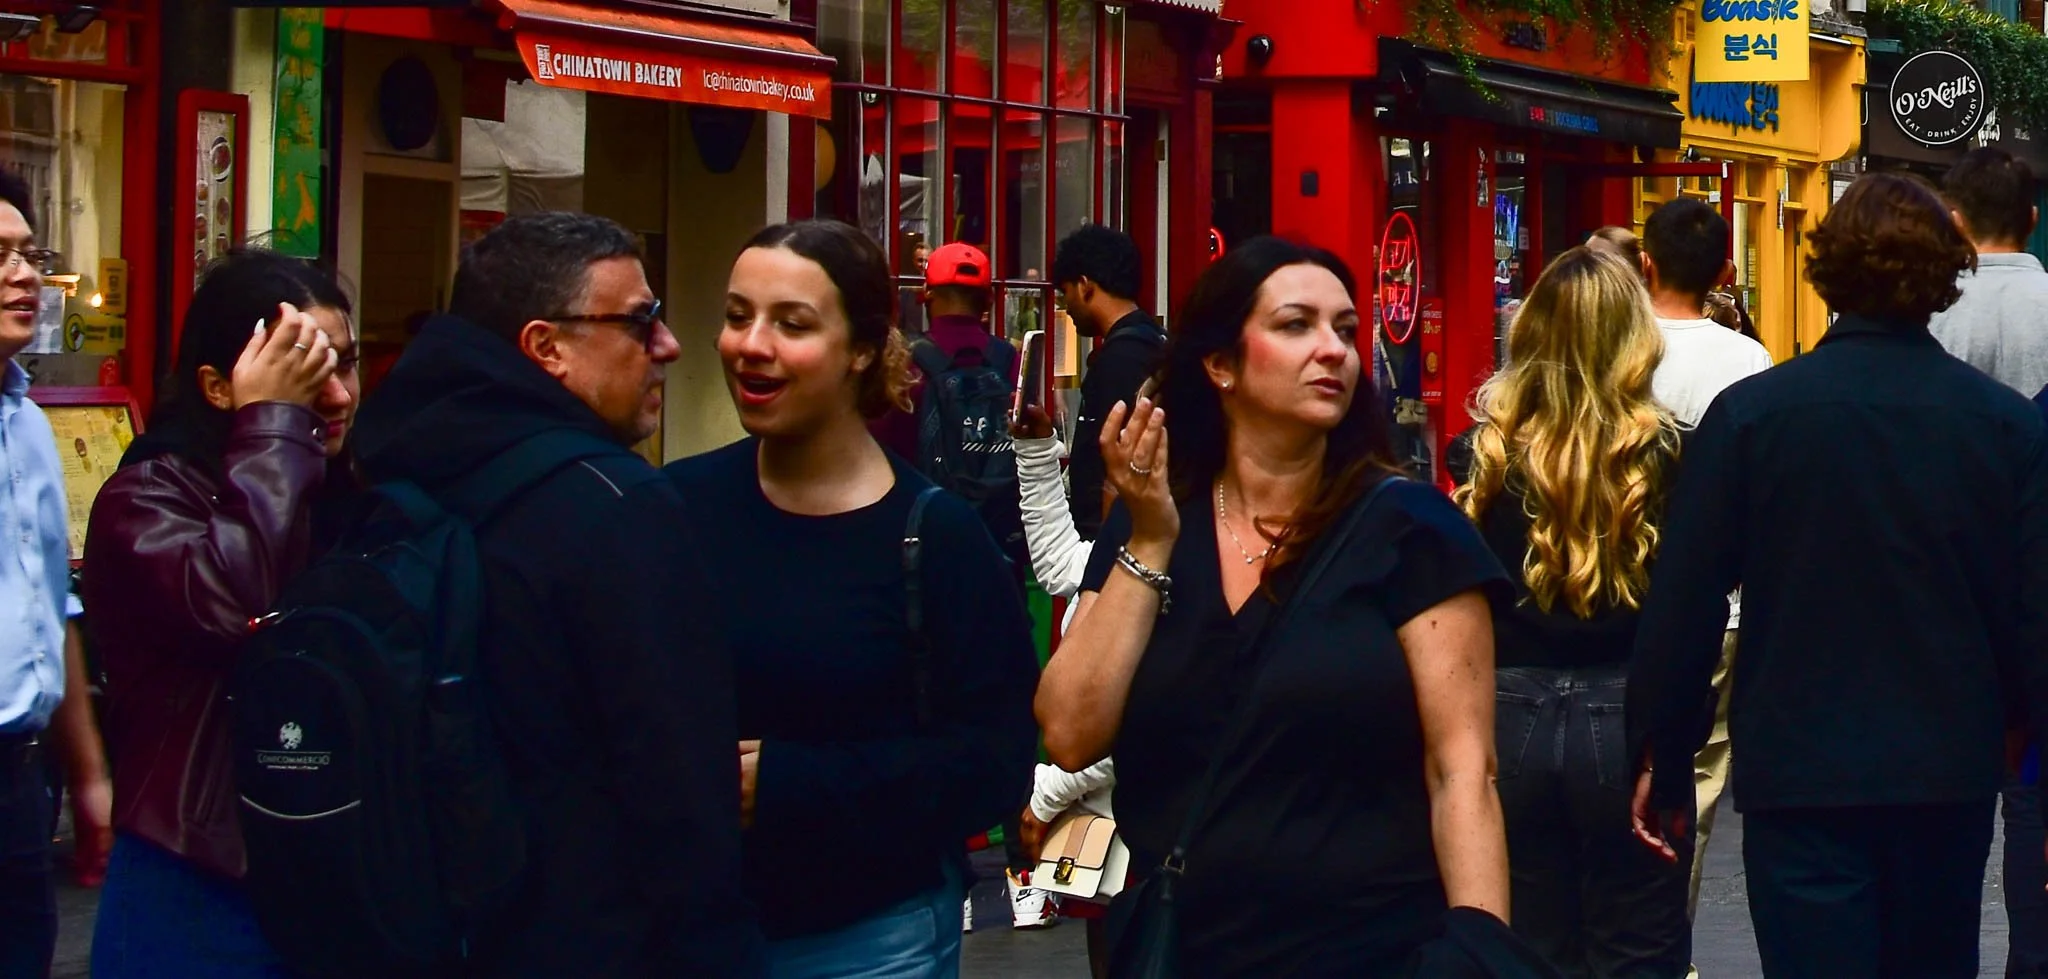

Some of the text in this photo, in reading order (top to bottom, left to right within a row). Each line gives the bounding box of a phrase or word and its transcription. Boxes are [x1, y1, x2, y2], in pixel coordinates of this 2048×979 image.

[1724, 33, 1778, 61] 분식
[553, 53, 632, 82] CHINATOWN
[635, 62, 682, 88] BAKERY
[1896, 75, 1976, 116] O'Neill's
[1905, 98, 1977, 138] EAT DRINK ENJOY
